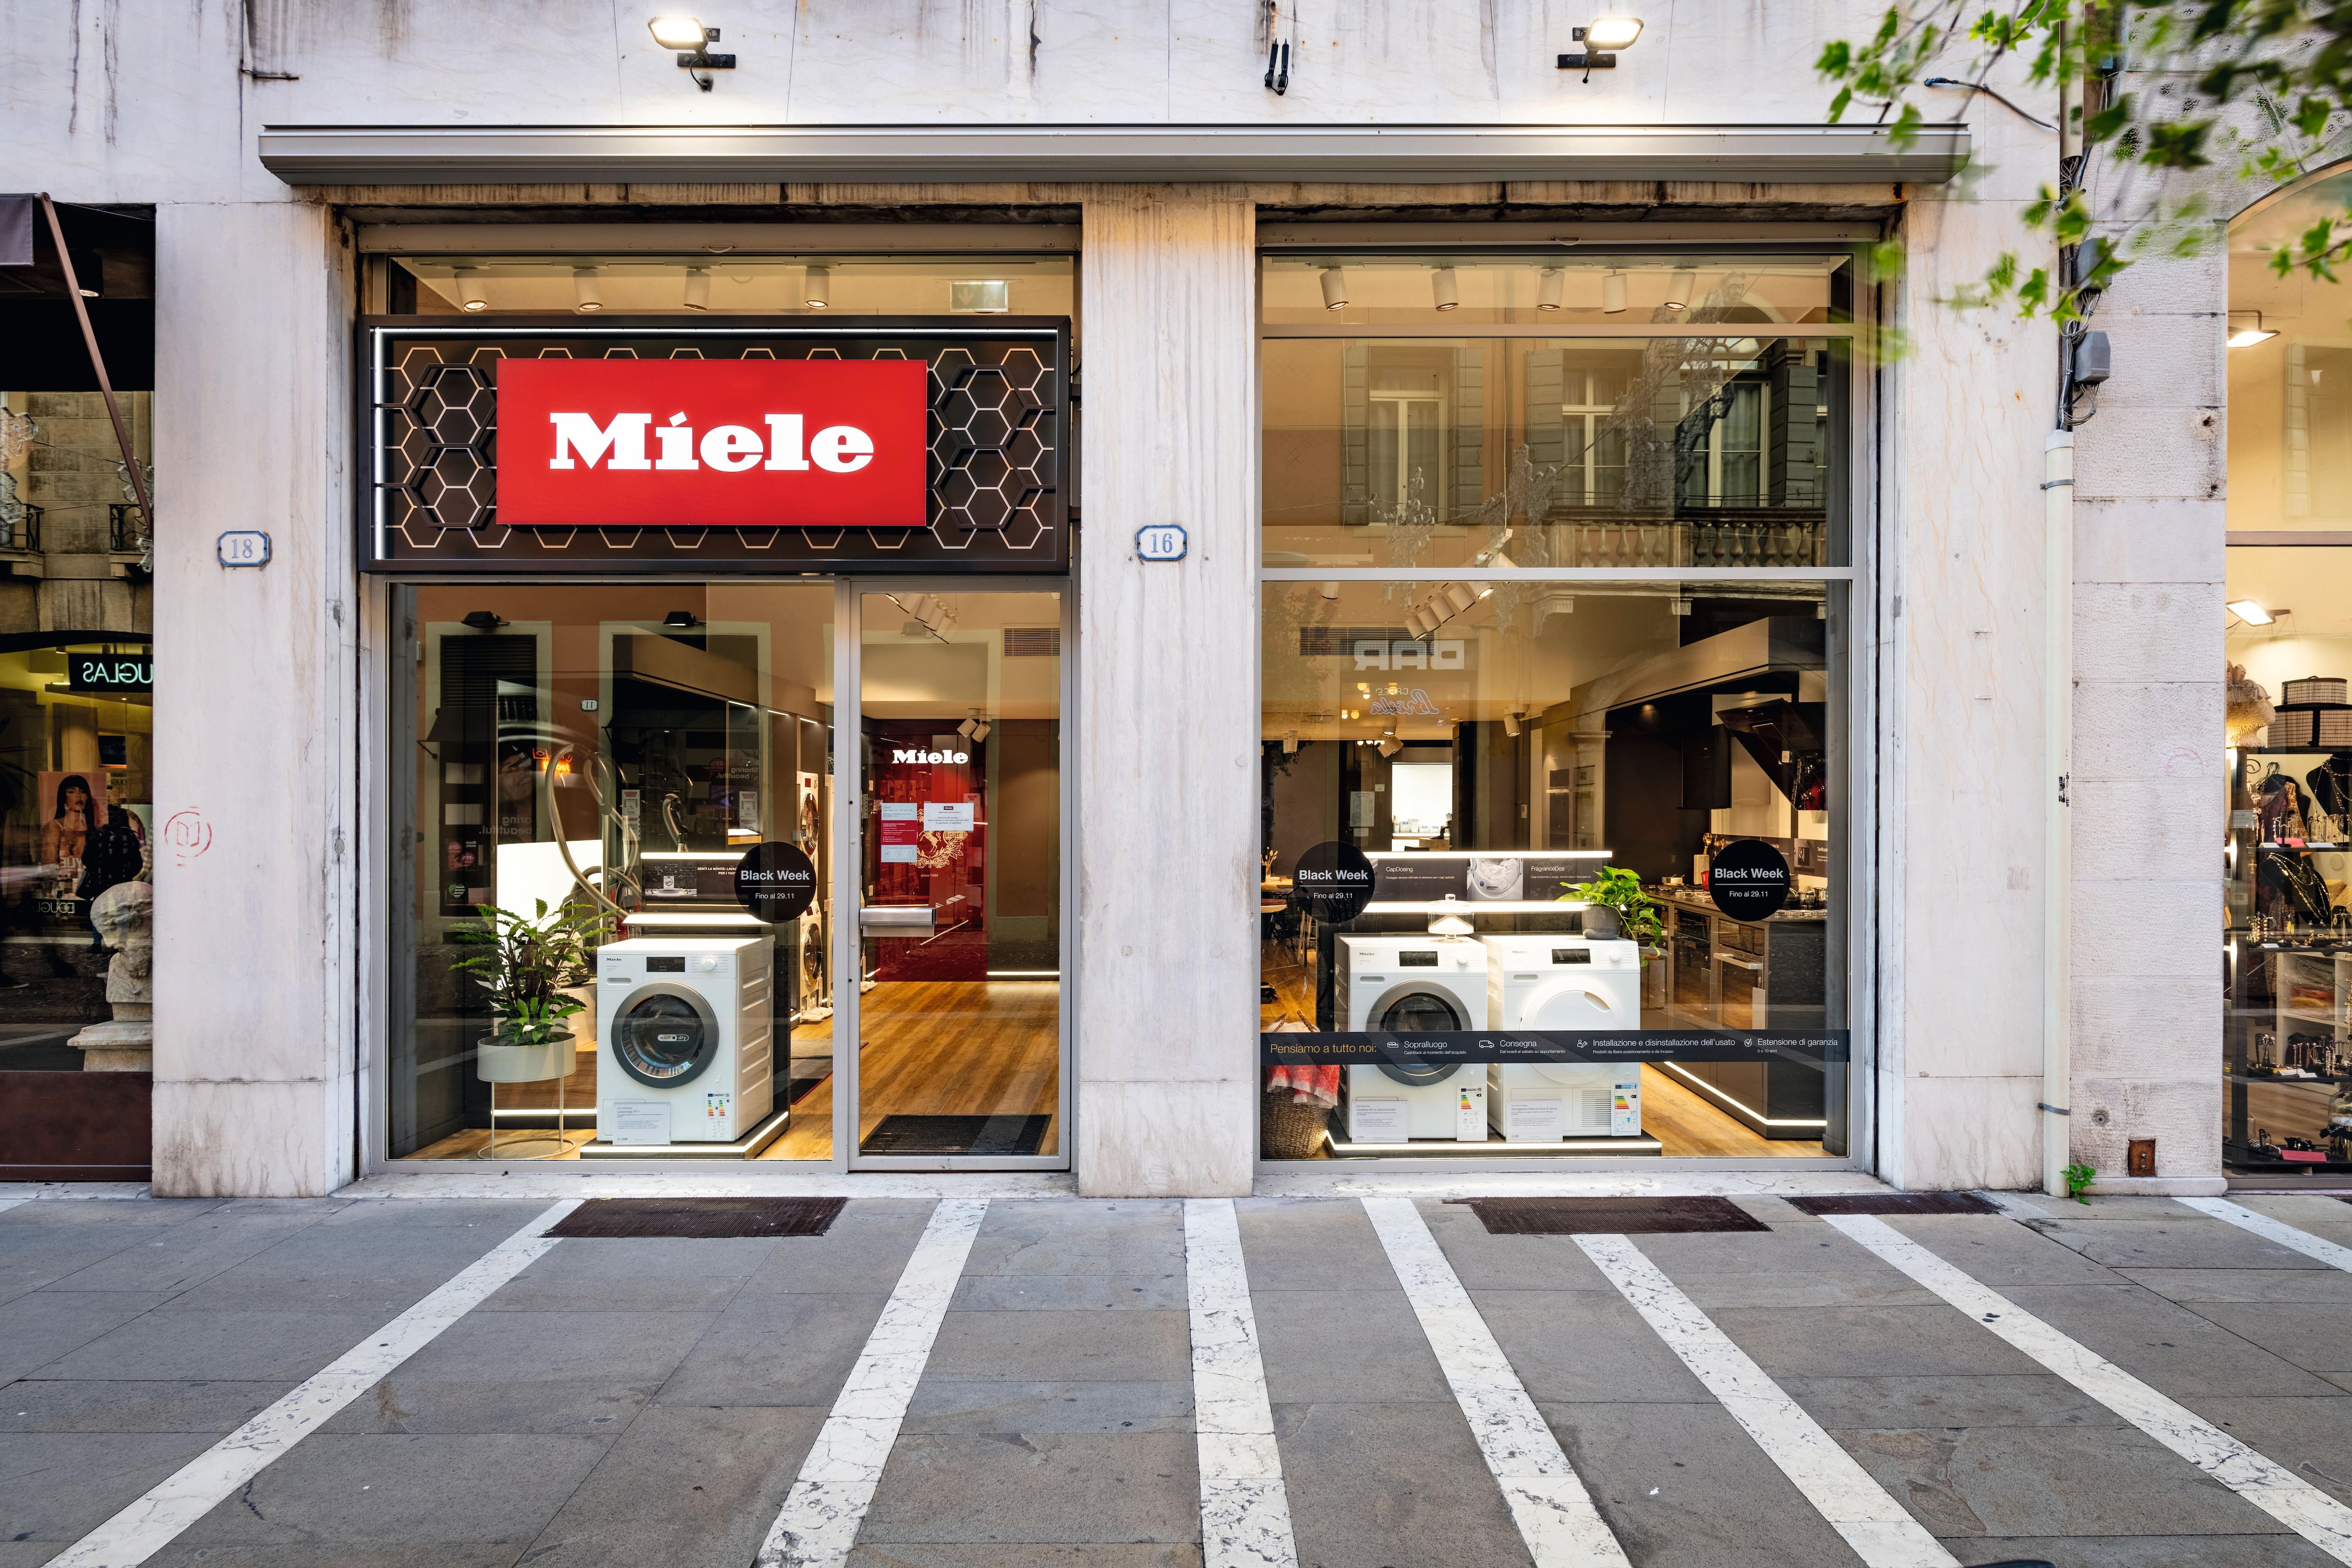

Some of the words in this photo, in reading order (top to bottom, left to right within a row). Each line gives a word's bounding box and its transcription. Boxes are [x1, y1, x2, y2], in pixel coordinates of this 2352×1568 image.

[549, 411, 874, 473] Miele
[1151, 533, 1173, 553] 16
[231, 539, 253, 558] 18
[891, 749, 969, 764] Miele
[741, 870, 774, 881] Black
[777, 870, 810, 880] Week
[1299, 870, 1332, 880] Black
[1335, 870, 1368, 880] Week
[1715, 868, 1748, 878] Black
[1751, 868, 1784, 878] Week
[1404, 1041, 1447, 1049] Sopralluogo
[1500, 1040, 1537, 1049] Consegna
[1807, 1038, 1838, 1047] garanzia
[1271, 1044, 1320, 1053] Pensiamo
[1332, 1044, 1356, 1053] tutto
[1359, 1043, 1377, 1052] noi:
